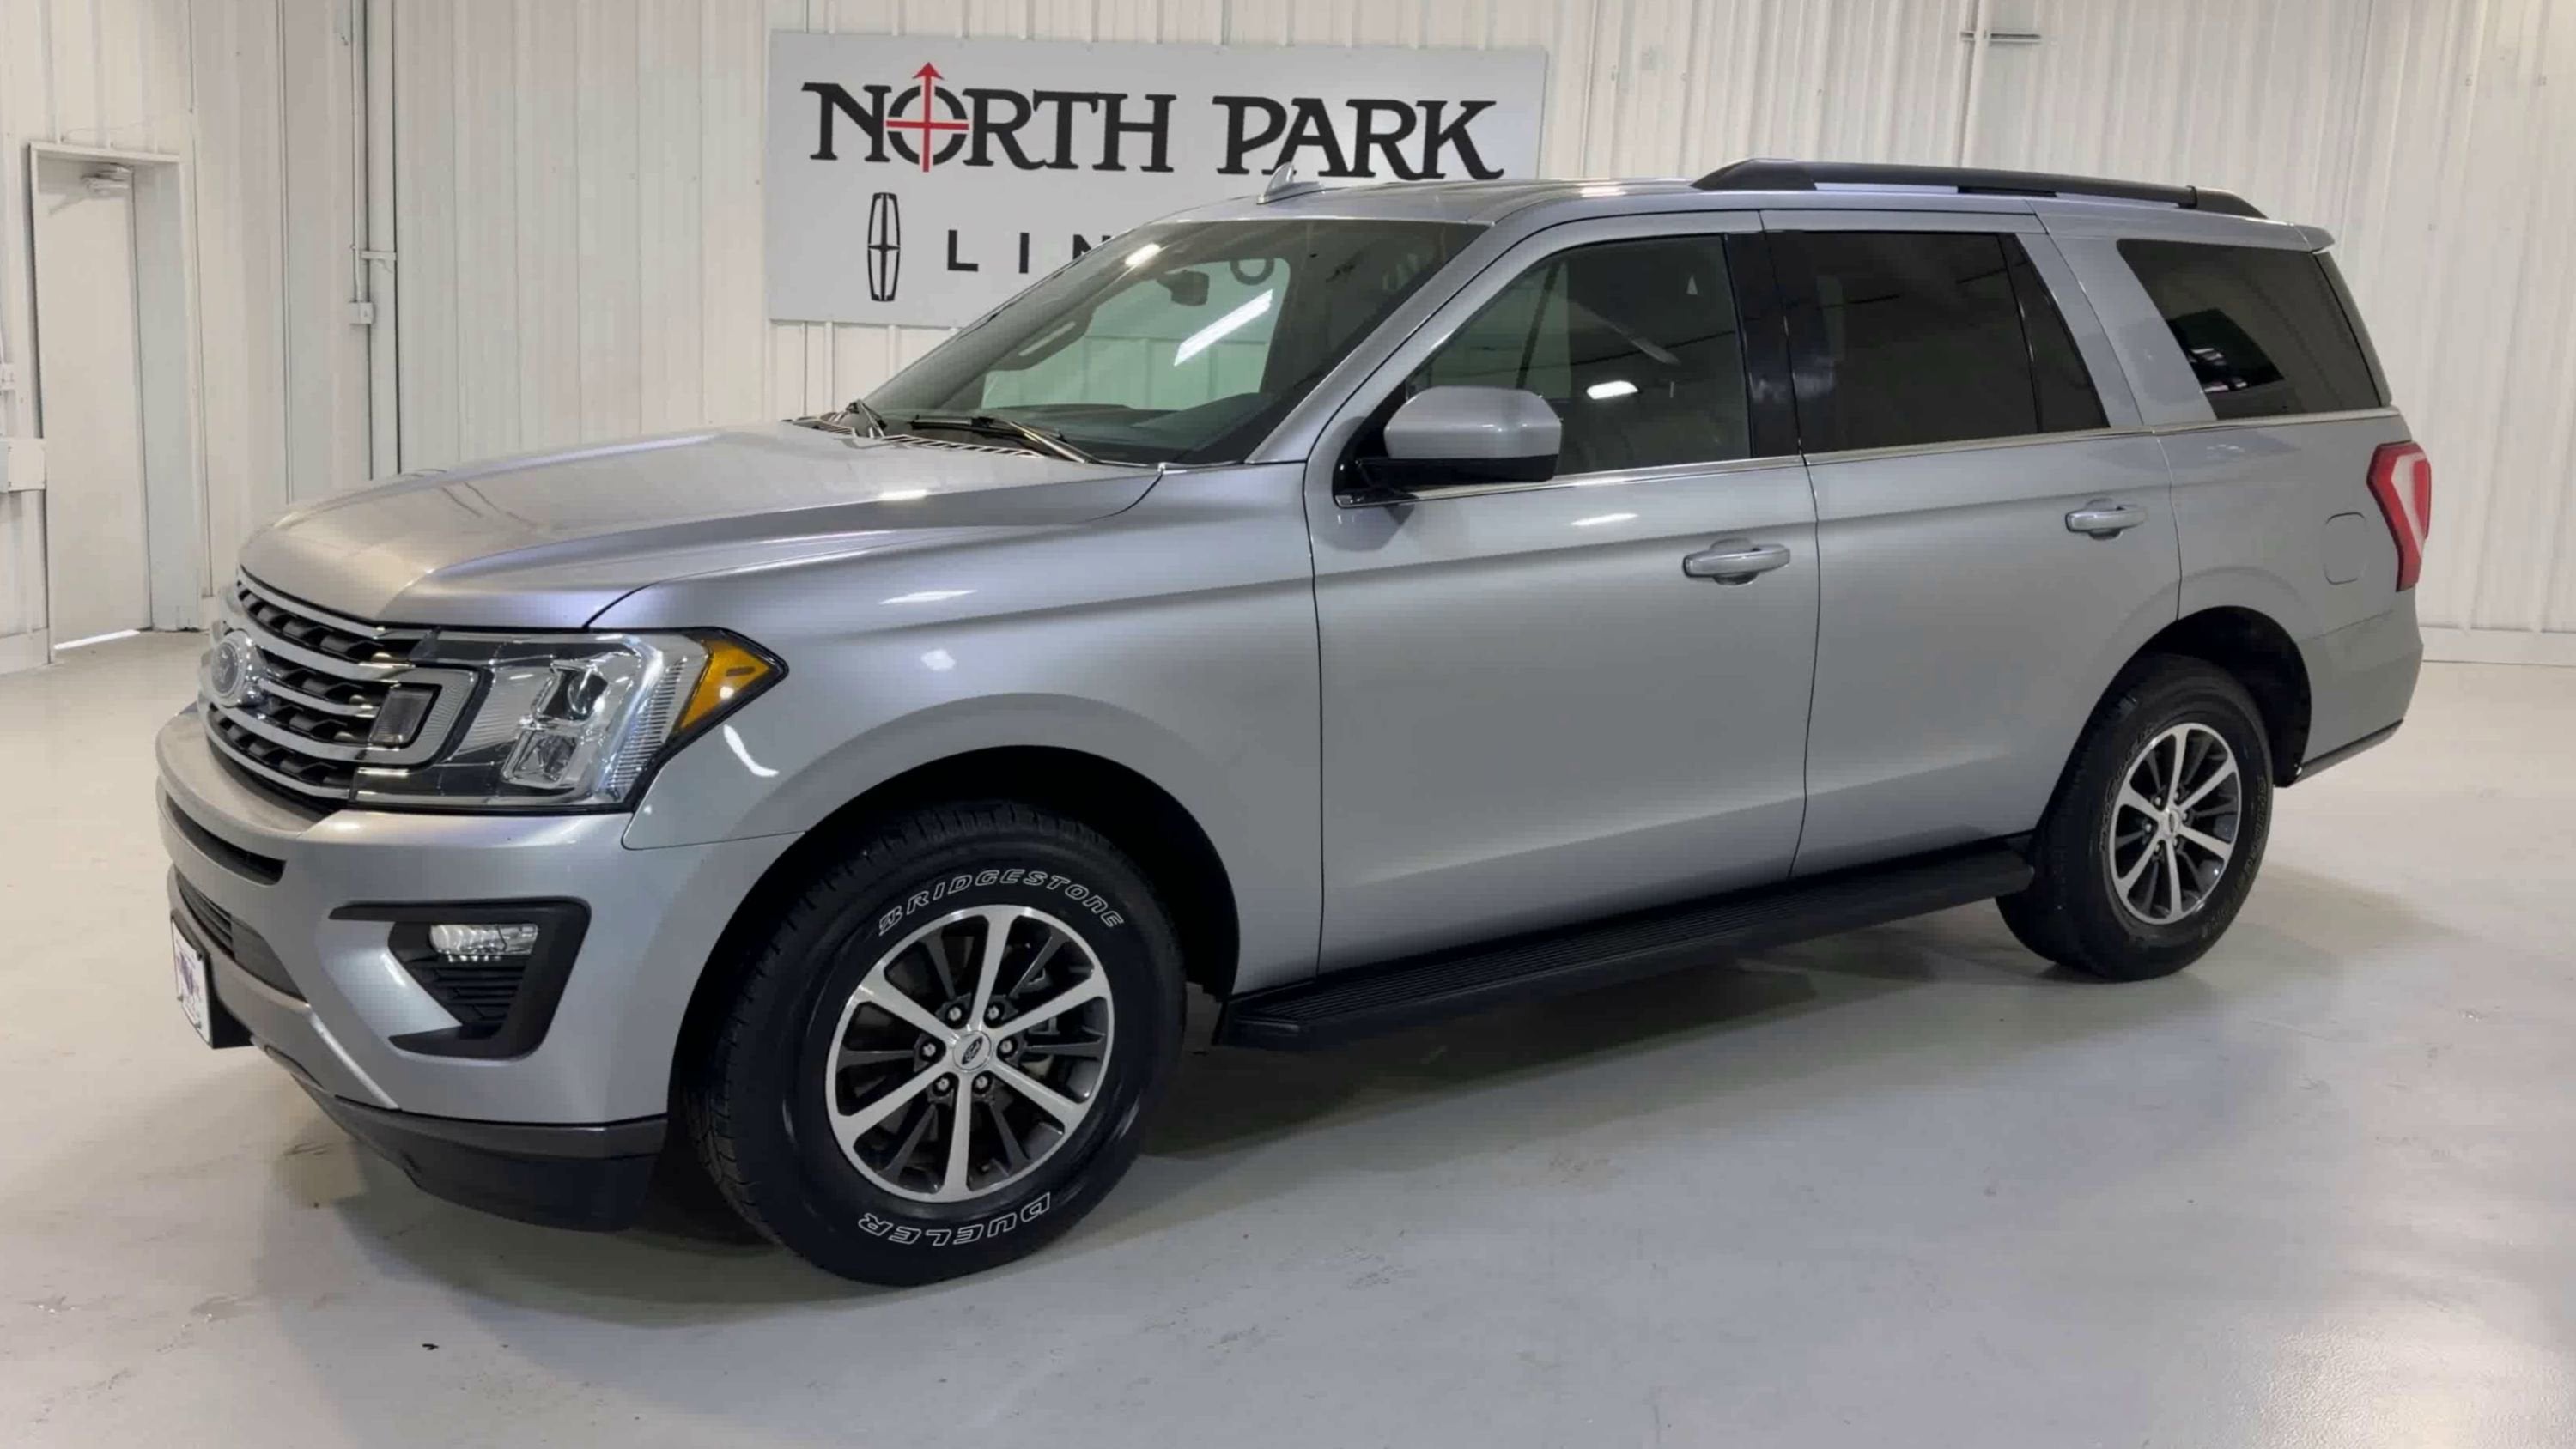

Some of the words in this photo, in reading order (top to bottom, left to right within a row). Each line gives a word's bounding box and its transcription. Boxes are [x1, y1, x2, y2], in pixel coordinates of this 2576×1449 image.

[801, 82, 1177, 173] NORTH
[1212, 95, 1504, 181] PARK
[878, 869, 1124, 937] BRIDGESTONE
[858, 1191, 1052, 1247] DUELER
